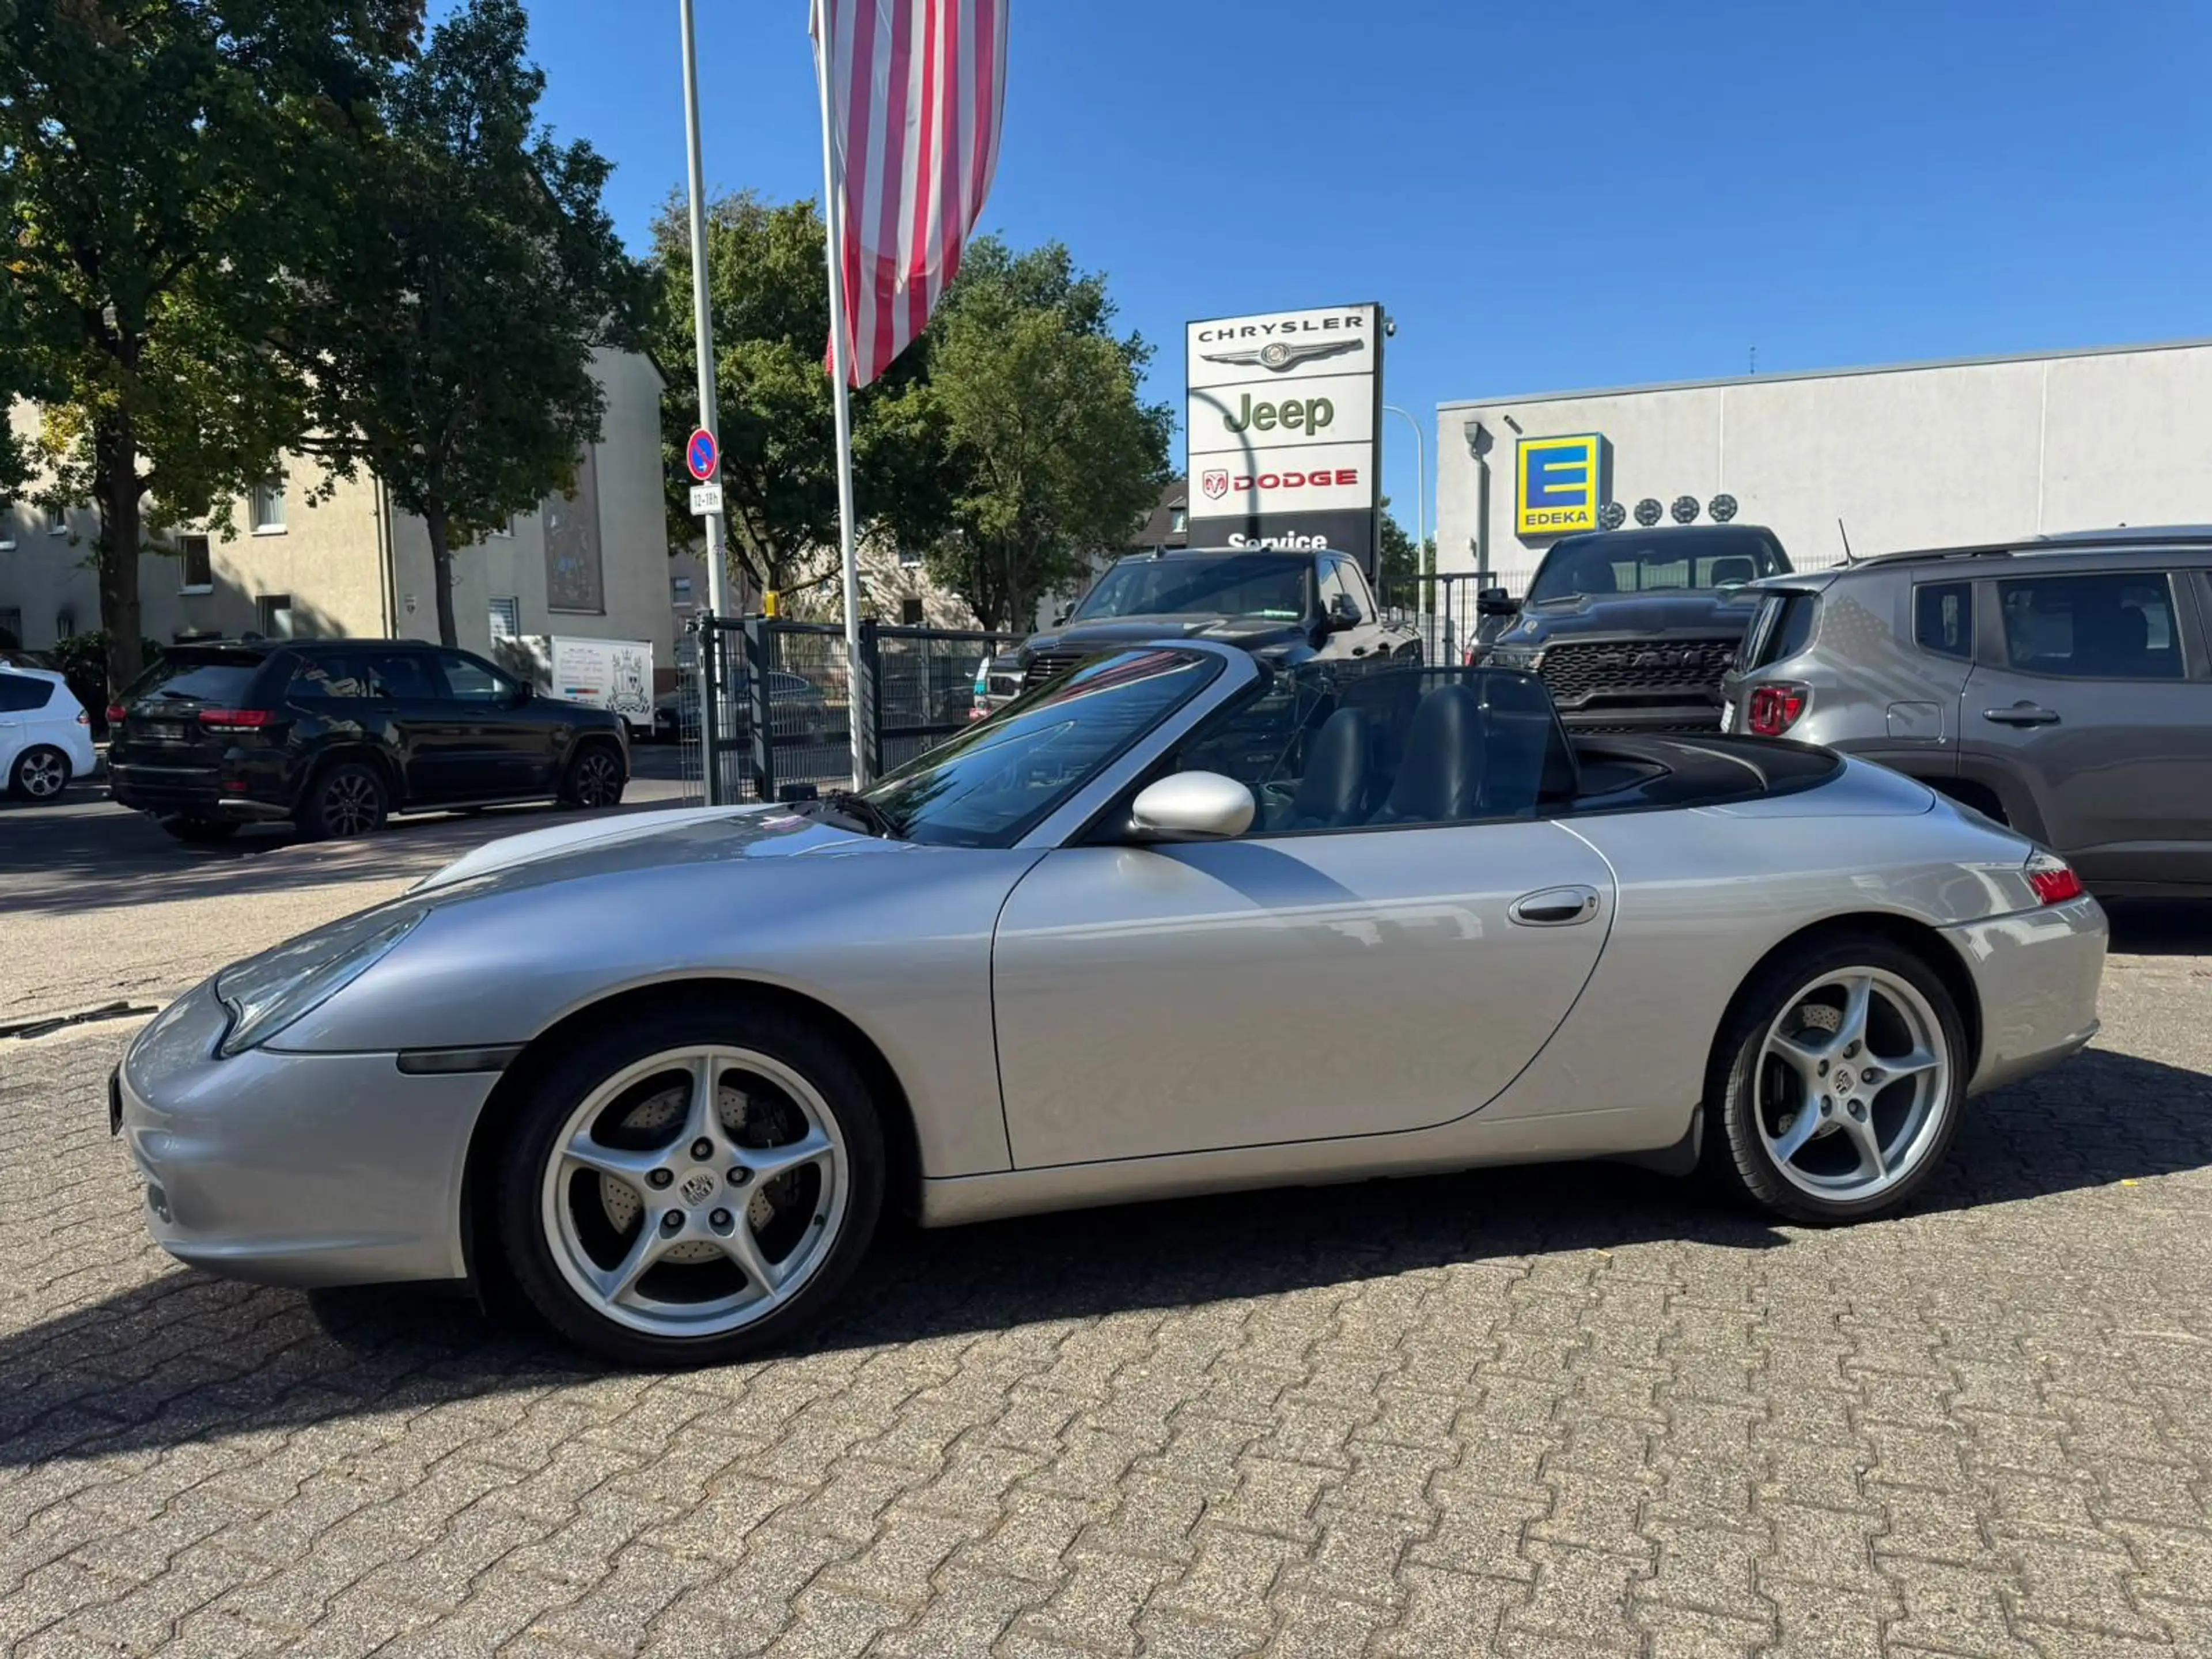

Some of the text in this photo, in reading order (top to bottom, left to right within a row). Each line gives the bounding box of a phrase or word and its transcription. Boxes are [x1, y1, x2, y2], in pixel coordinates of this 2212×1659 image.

[1198, 316, 1363, 342] CHRYSLER
[1224, 393, 1334, 437] Jeep
[1234, 469, 1358, 491] DODGE
[1525, 511, 1589, 526] EDEKA
